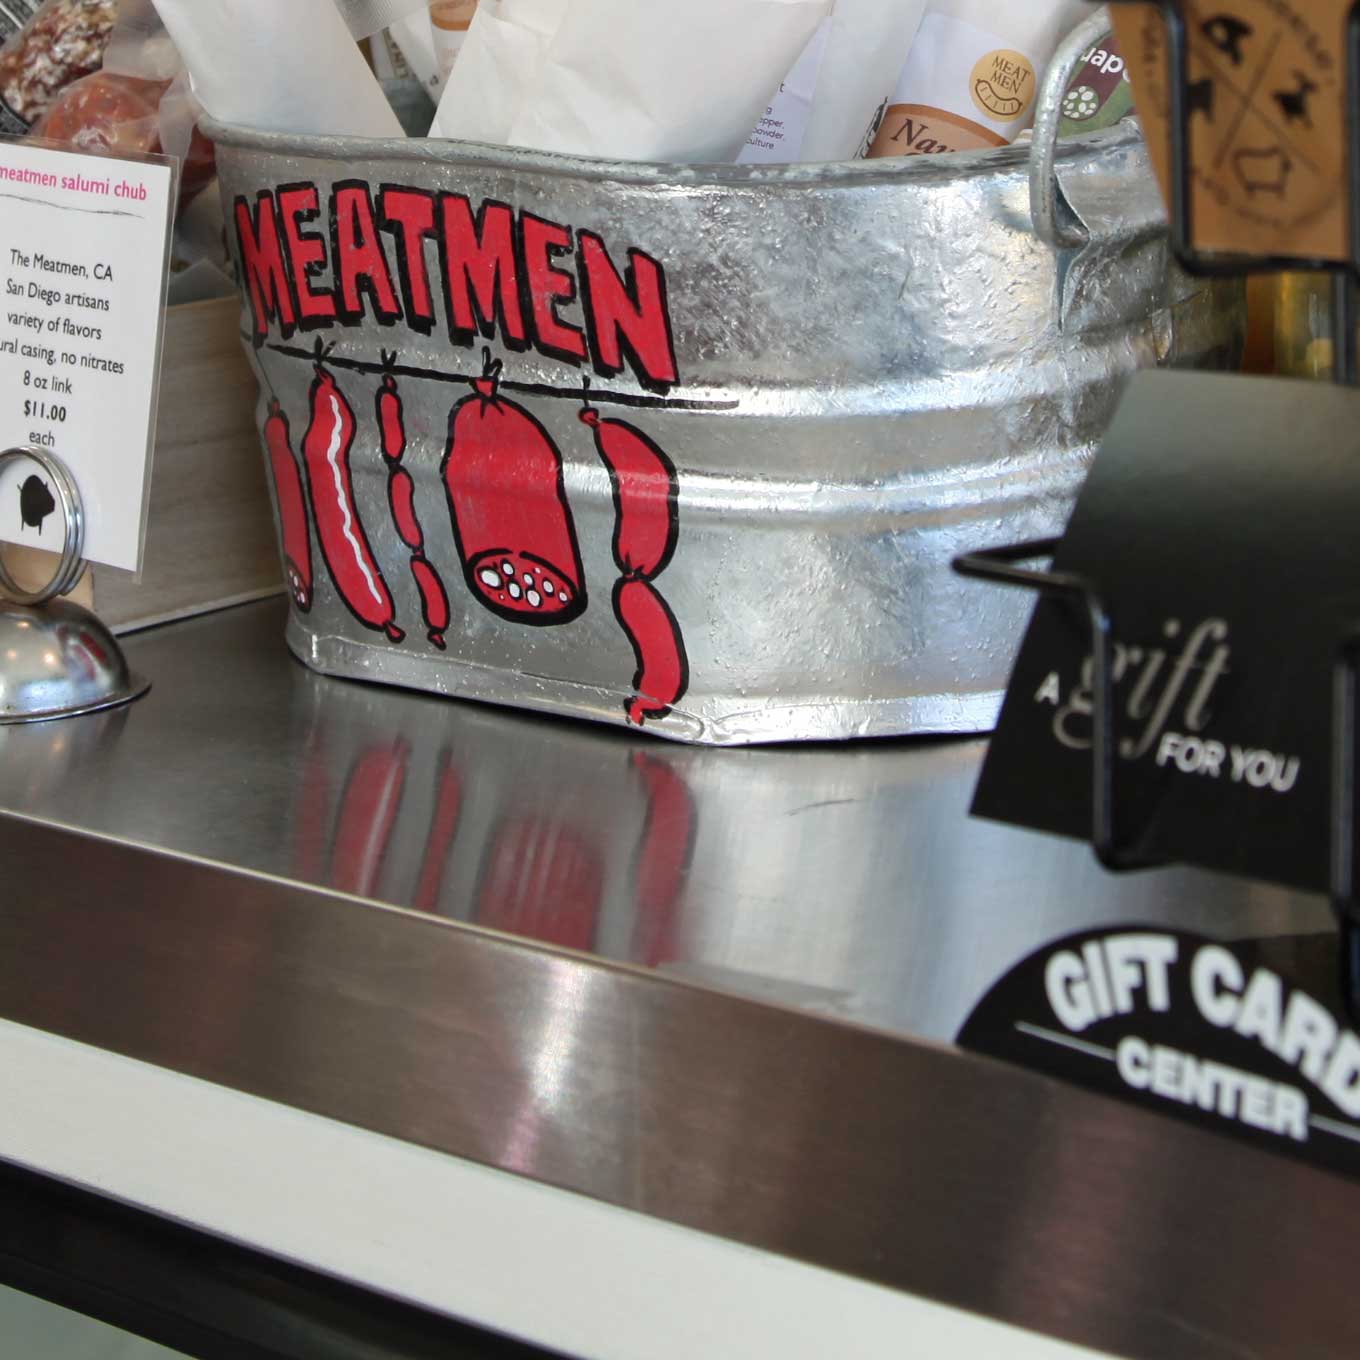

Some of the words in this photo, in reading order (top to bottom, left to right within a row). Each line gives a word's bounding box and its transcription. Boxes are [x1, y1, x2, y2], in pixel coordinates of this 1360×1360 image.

[991, 55, 1031, 82] MEAT
[1079, 47, 1131, 83] uap
[990, 70, 1022, 94] MEN
[61, 174, 110, 196] salumi
[114, 181, 147, 201] chub
[10, 248, 30, 268] The
[33, 254, 89, 280] Meatmen,
[93, 263, 113, 282] CA
[6, 278, 24, 297] San
[28, 282, 61, 306] Diego
[64, 291, 110, 312] artisans
[233, 180, 682, 394] MEATMEN
[7, 310, 44, 334] variety
[47, 313, 61, 333] of
[63, 317, 103, 341] flavors
[21, 342, 56, 365] casing,
[61, 350, 77, 366] no
[80, 351, 125, 375] nitrates
[23, 370, 31, 387] 8
[33, 376, 48, 391] oz
[51, 375, 73, 395] link
[24, 399, 67, 423] $11.00
[29, 430, 55, 448] each
[1034, 671, 1060, 704] A
[1156, 732, 1227, 778] FOR
[1227, 748, 1301, 793] YOU
[1044, 933, 1179, 1033] GIFT
[1116, 1037, 1312, 1143] CENTER
